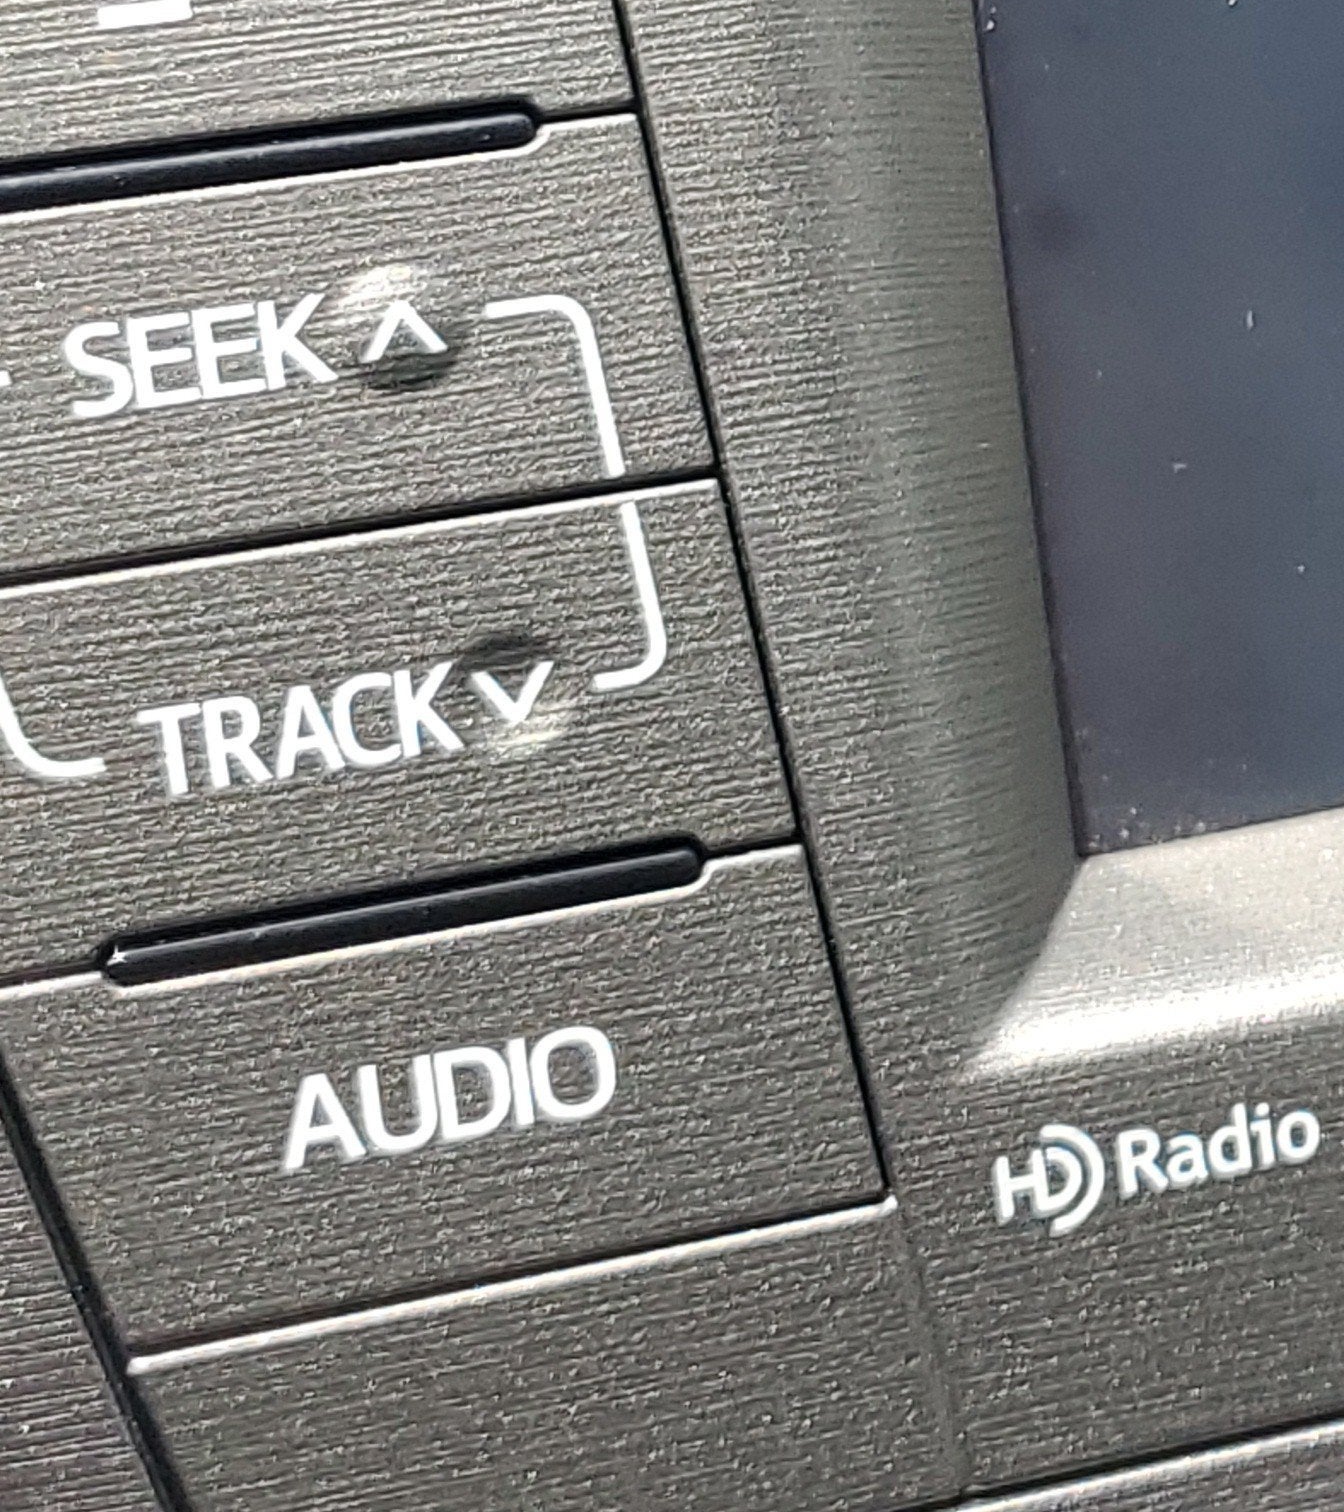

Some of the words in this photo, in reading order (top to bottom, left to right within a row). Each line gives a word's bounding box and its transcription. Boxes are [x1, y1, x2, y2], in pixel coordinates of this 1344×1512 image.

[61, 292, 338, 417] SEEK
[137, 661, 465, 797] TRACK
[284, 1026, 618, 1174] AUDIO
[994, 1123, 1105, 1236] HD
[1117, 1102, 1321, 1200] Radio
